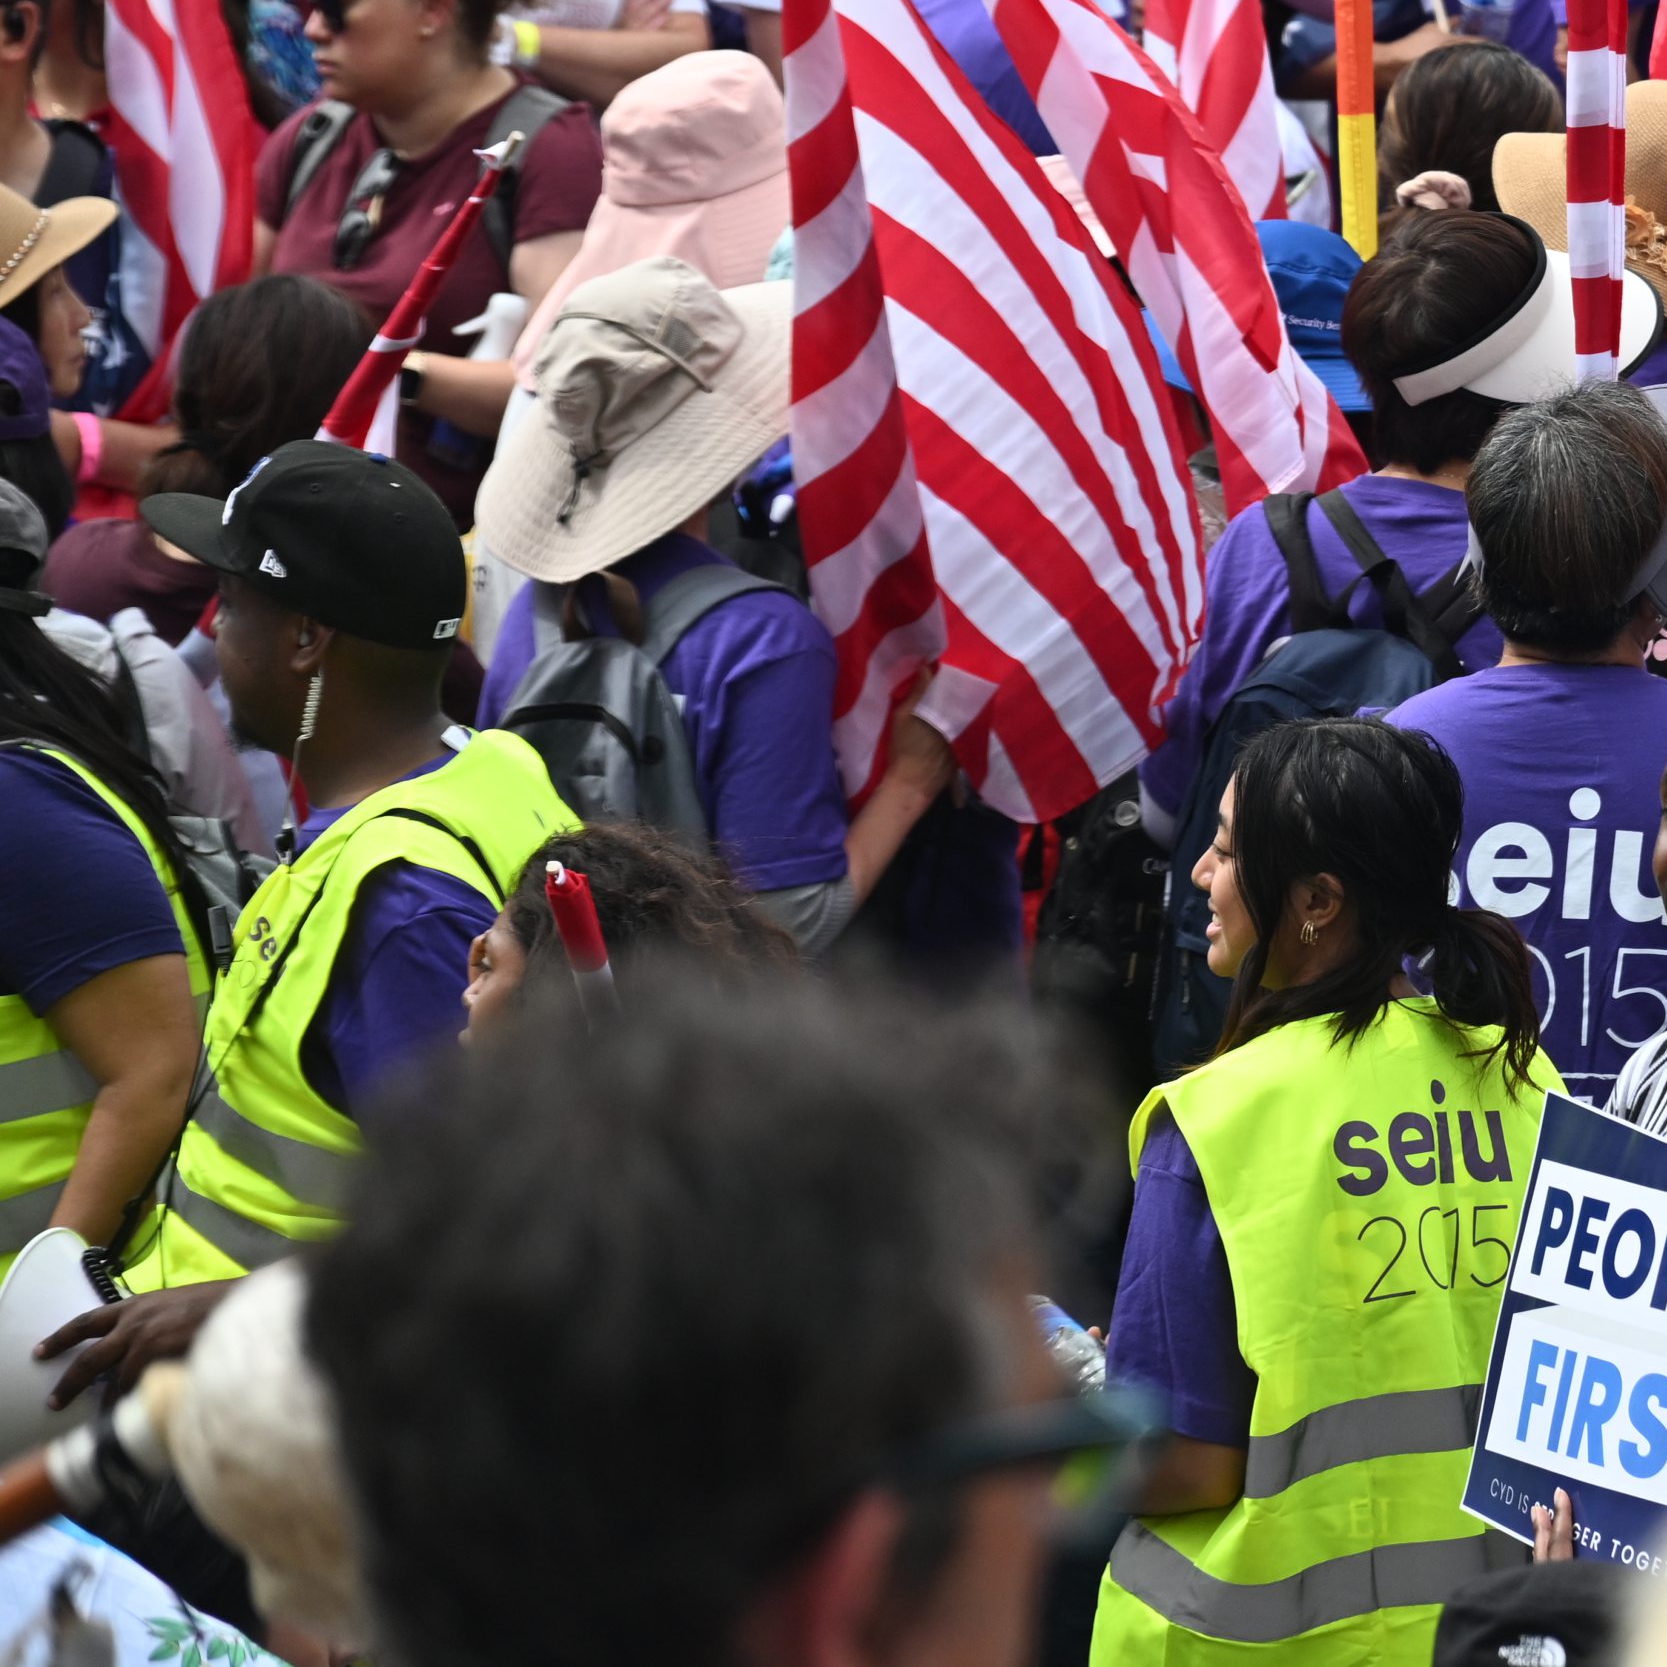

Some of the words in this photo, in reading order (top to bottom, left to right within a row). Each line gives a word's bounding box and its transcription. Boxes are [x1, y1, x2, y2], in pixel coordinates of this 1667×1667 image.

[1333, 1079, 1513, 1197] seiu
[1356, 1205, 1513, 1305] 2015
[1518, 1492, 1530, 1514] IS
